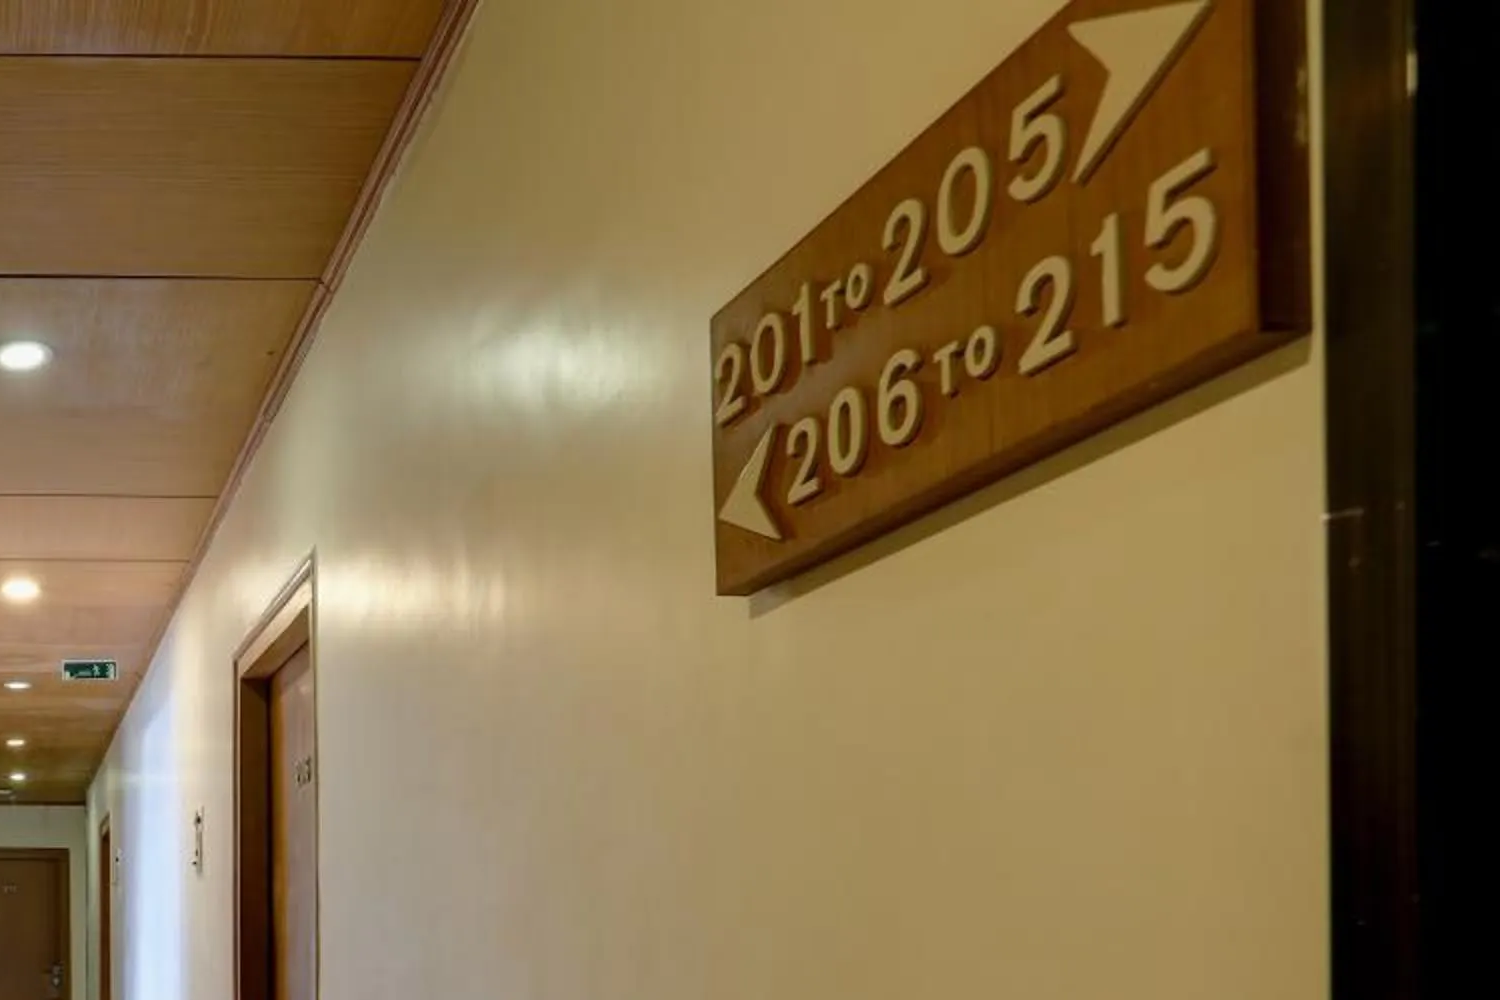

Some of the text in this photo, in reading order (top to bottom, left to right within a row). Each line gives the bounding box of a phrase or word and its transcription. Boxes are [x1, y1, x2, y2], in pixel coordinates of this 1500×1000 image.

[714, 74, 1066, 428] 201 TO 205
[786, 147, 1218, 507] 206 TO 215
